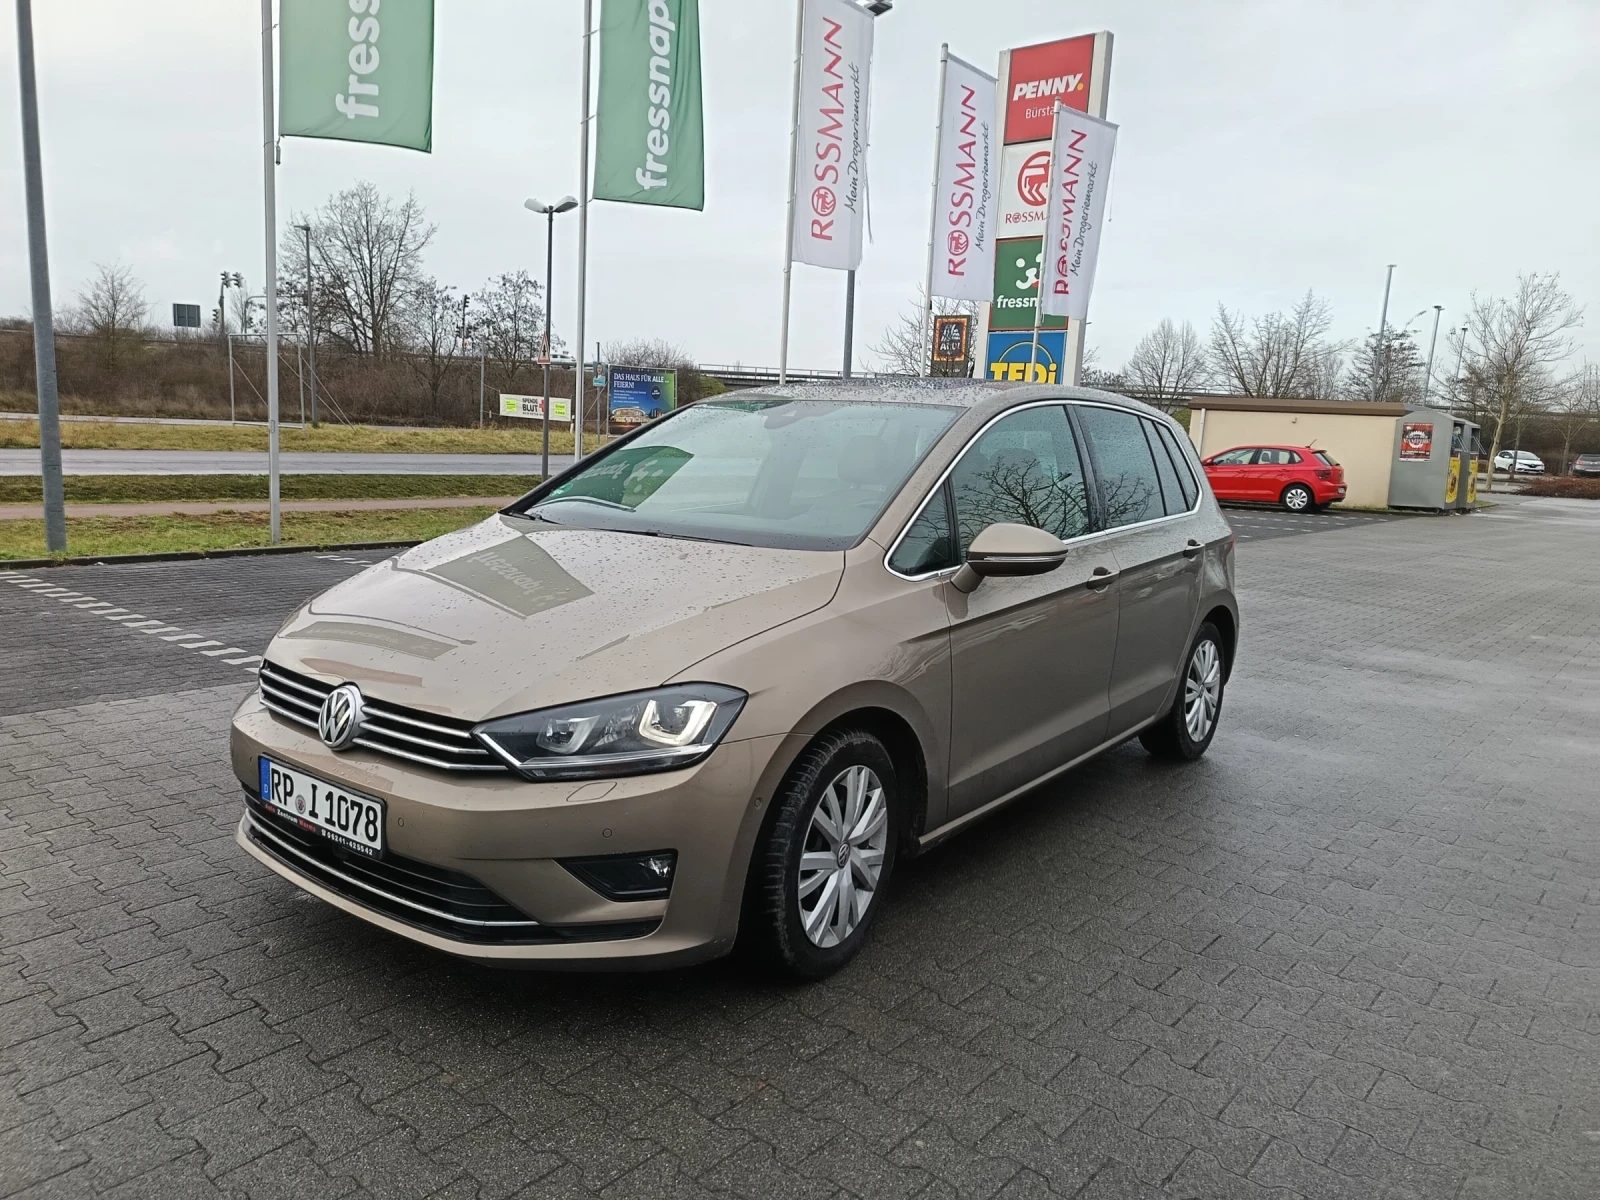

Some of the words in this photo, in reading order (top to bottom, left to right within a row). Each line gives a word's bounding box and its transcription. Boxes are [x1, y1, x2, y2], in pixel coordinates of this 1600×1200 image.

[335, 0, 380, 119] fress
[635, 0, 676, 190] fressnap
[847, 61, 863, 175] Drogeriemarkt
[1025, 105, 1056, 119] Bürsta
[811, 16, 845, 241] ROSSMANN
[844, 174, 859, 214] Mein
[947, 84, 977, 276] ROSSMANN
[976, 120, 992, 220] Drogeriemarkt
[1005, 210, 1044, 224] ROSSM
[1073, 160, 1098, 248] Drogeriemarkt
[974, 220, 985, 253] Mein
[1069, 248, 1083, 277] Mein
[996, 294, 1037, 309] fressn
[522, 403, 538, 412] BLUT
[652, 375, 665, 383] ALLE
[271, 767, 294, 806] RP
[308, 783, 319, 820] I
[324, 790, 379, 843] 1078
